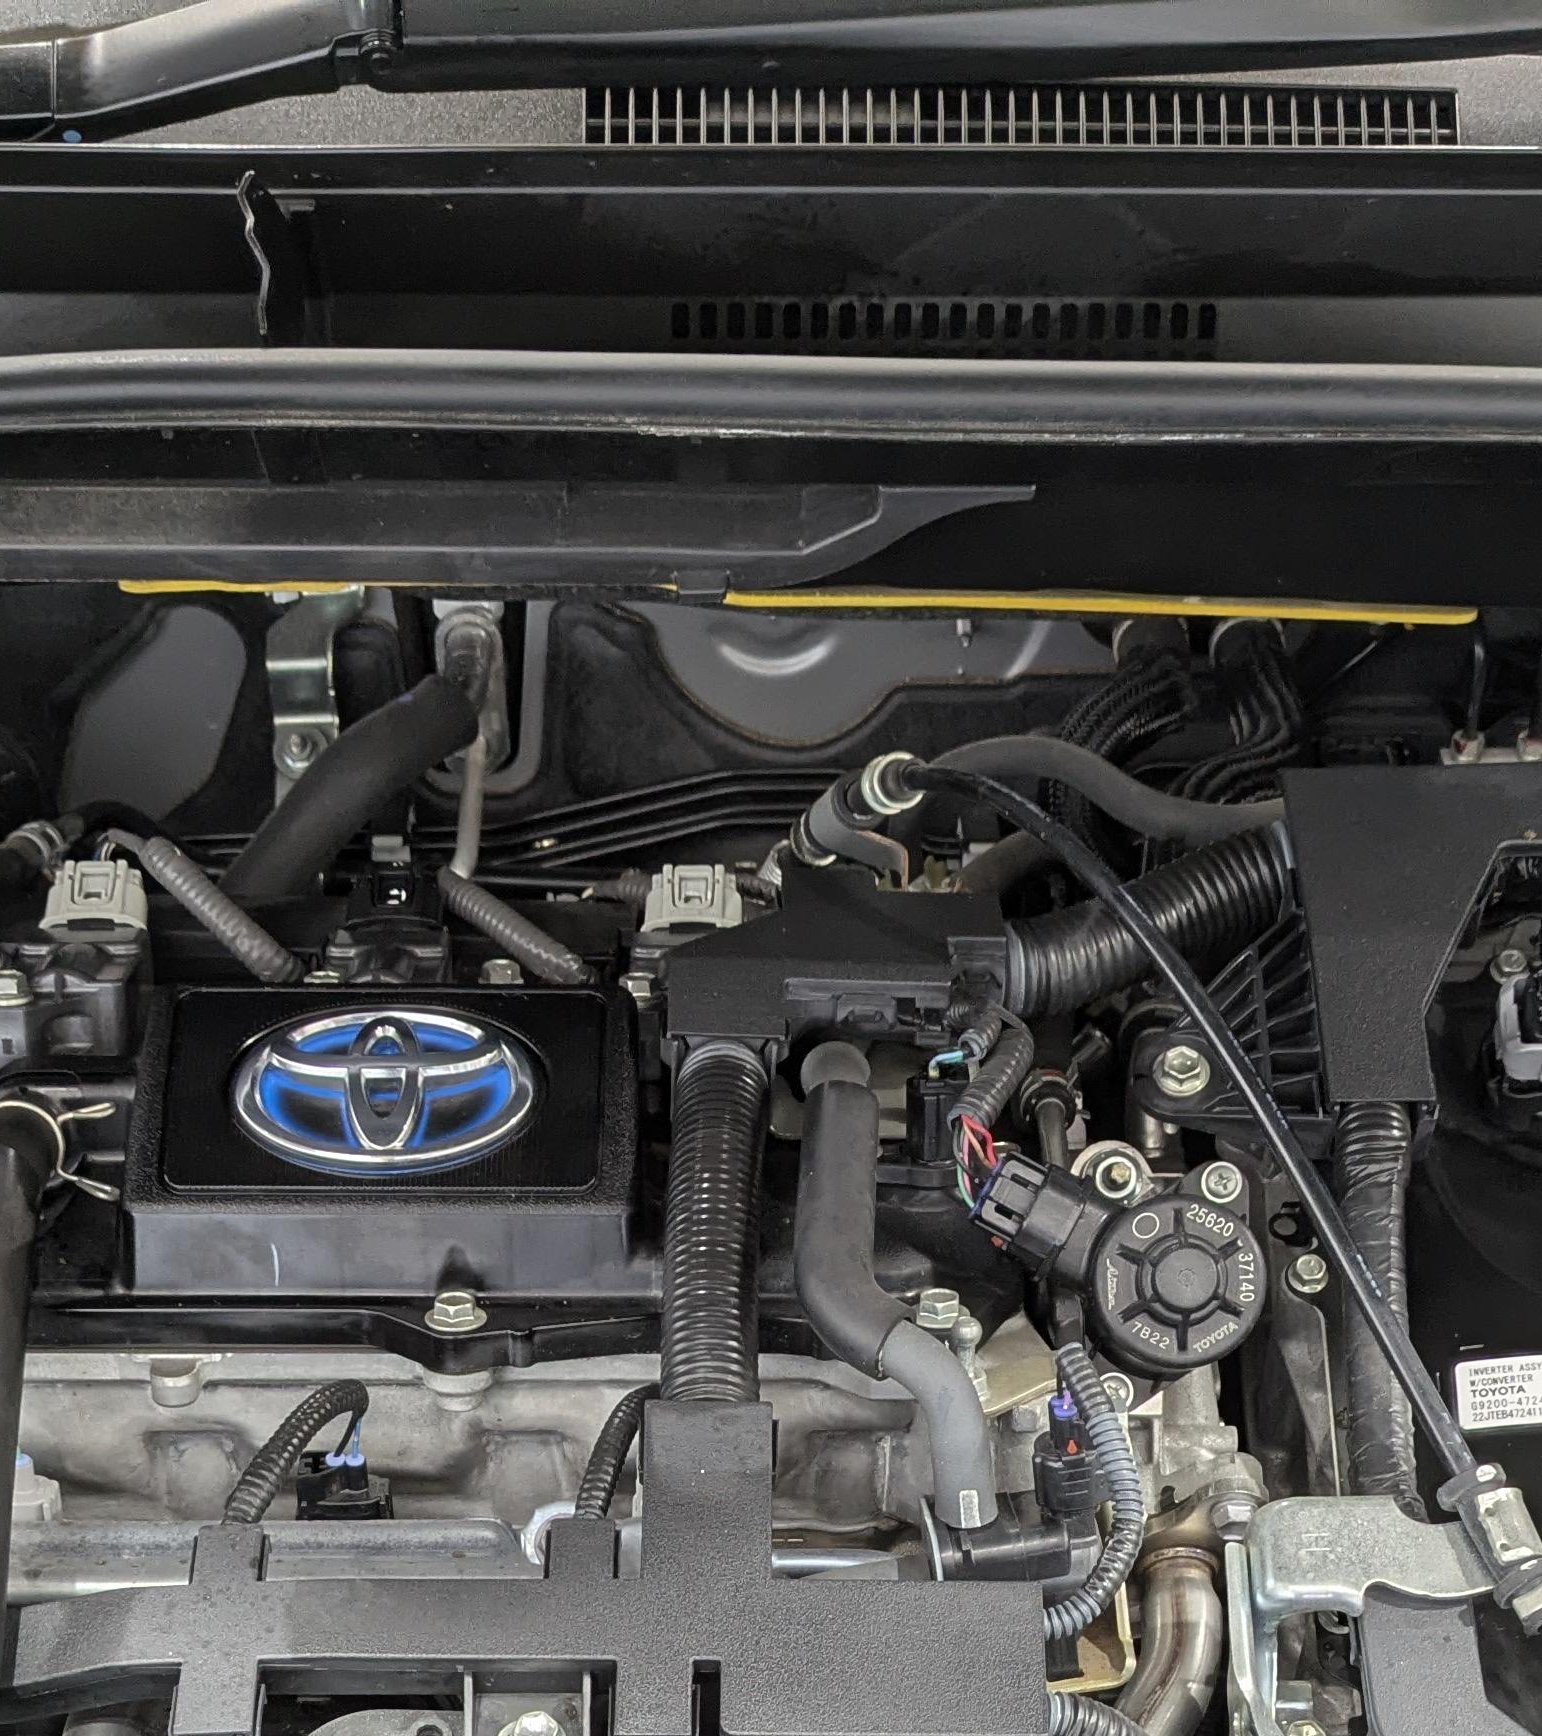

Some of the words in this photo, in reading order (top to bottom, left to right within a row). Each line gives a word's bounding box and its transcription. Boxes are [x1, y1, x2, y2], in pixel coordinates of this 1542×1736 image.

[1130, 1320, 1170, 1350] 7B22
[1192, 1320, 1240, 1353] TOYOTA
[1469, 1365, 1513, 1376] INVERTER
[1518, 1362, 1542, 1371] ASSY
[1469, 1374, 1533, 1387] W/CONVERTER
[1470, 1385, 1526, 1398] TOYOTA
